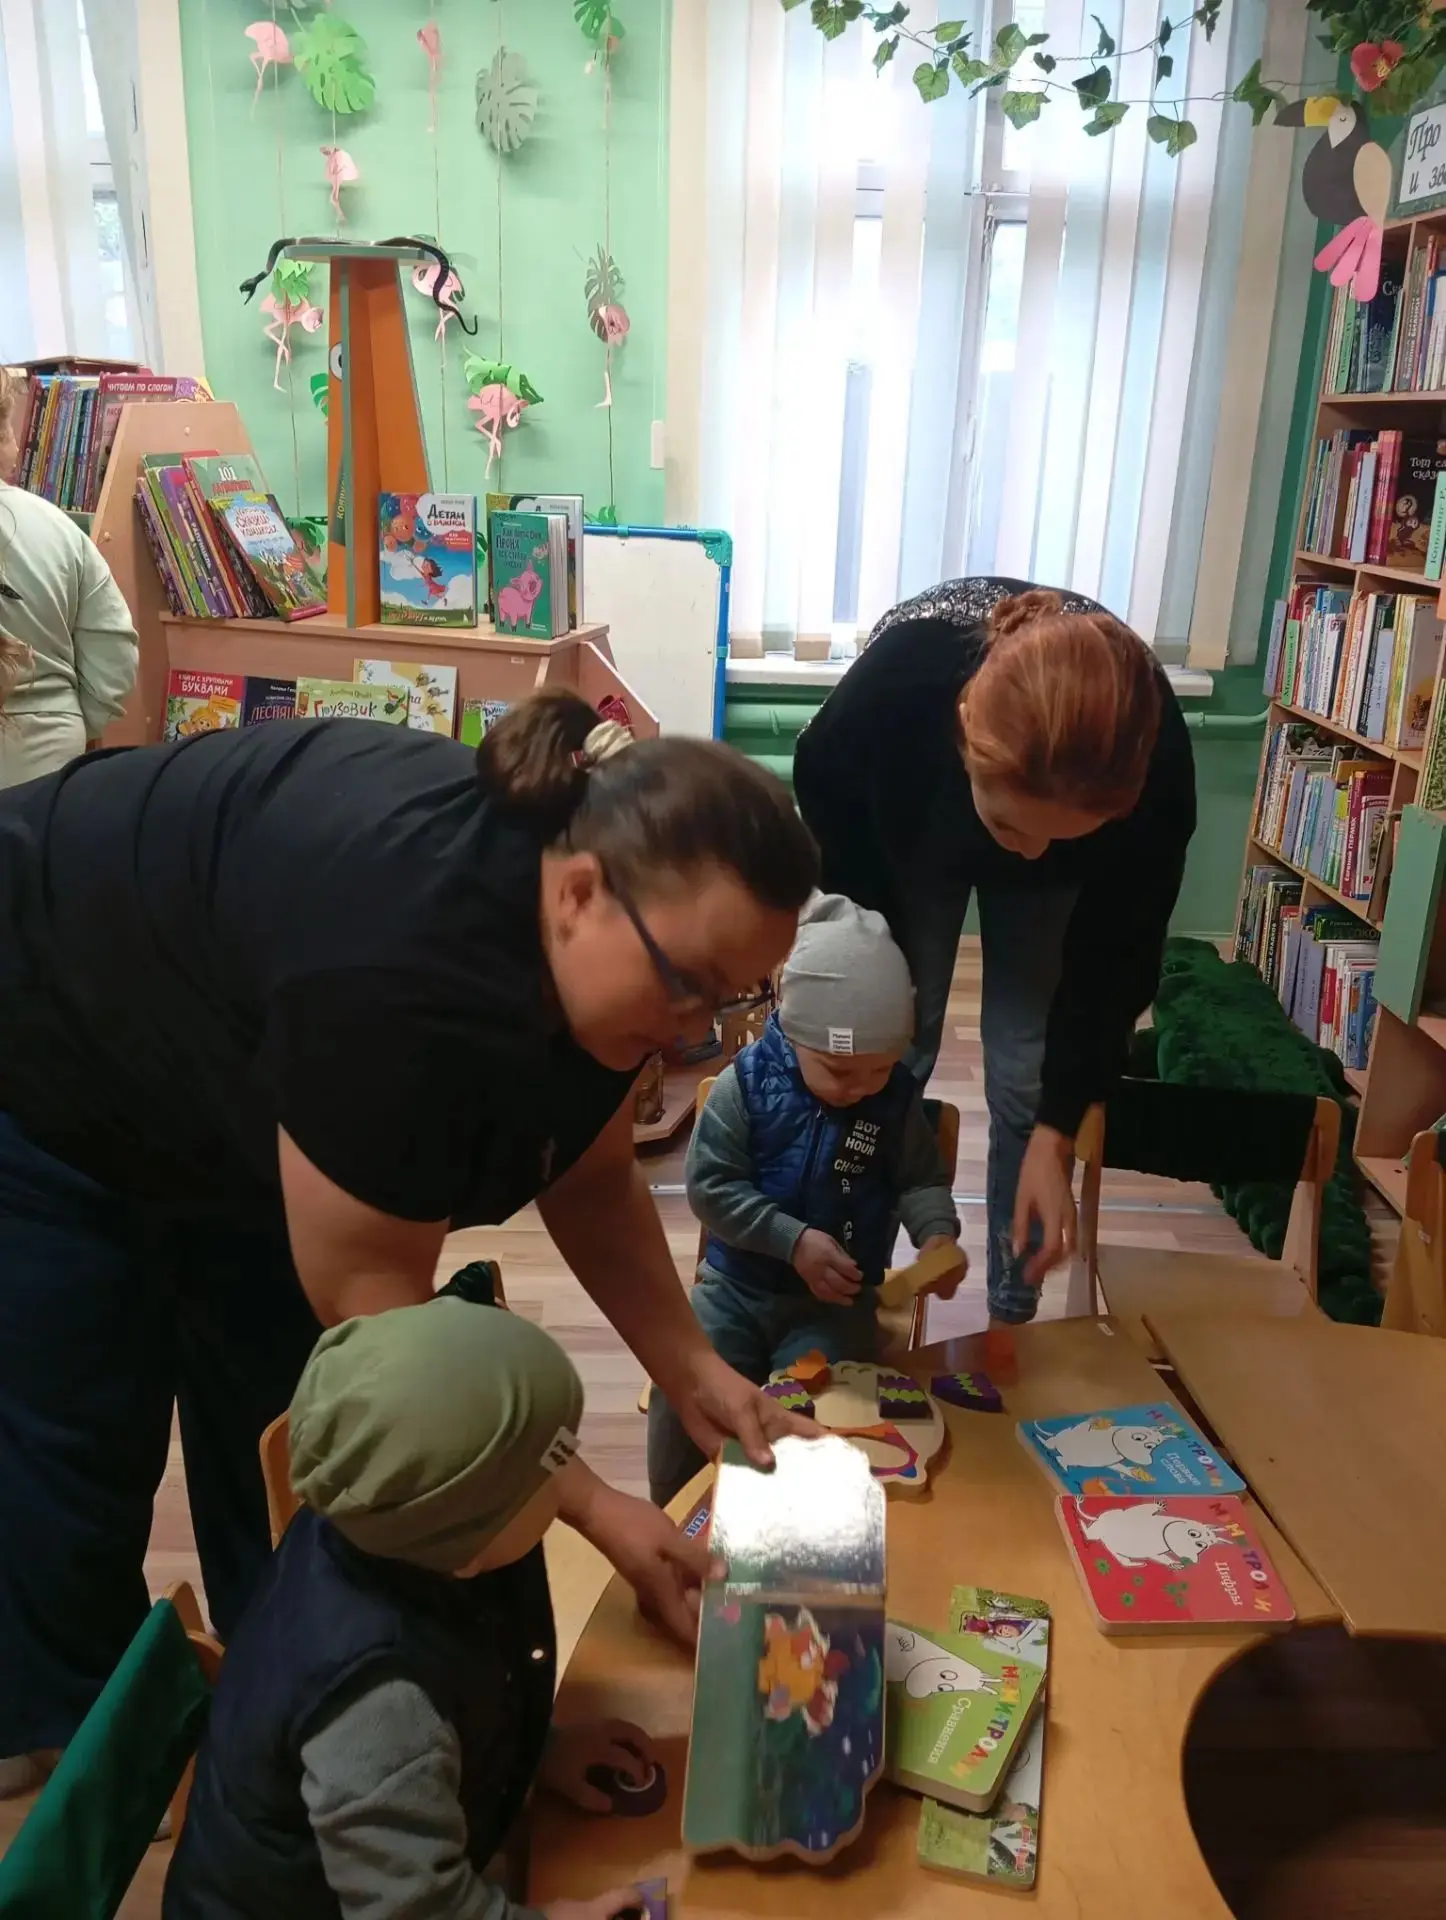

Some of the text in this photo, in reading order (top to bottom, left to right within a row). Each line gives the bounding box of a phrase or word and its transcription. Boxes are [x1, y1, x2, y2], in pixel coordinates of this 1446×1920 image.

[1408, 116, 1441, 162] Про
[218, 466, 237, 481] 101
[191, 522, 212, 569] РАПУНЦЕЛЬ
[181, 681, 229, 696] БУКВАМИ
[1348, 816, 1358, 850] ПЕРМЯК
[854, 1119, 881, 1136] BOY
[845, 1136, 875, 1156] HOUR
[1215, 1561, 1243, 1606] Цифры
[928, 1697, 971, 1765] Сравнения
